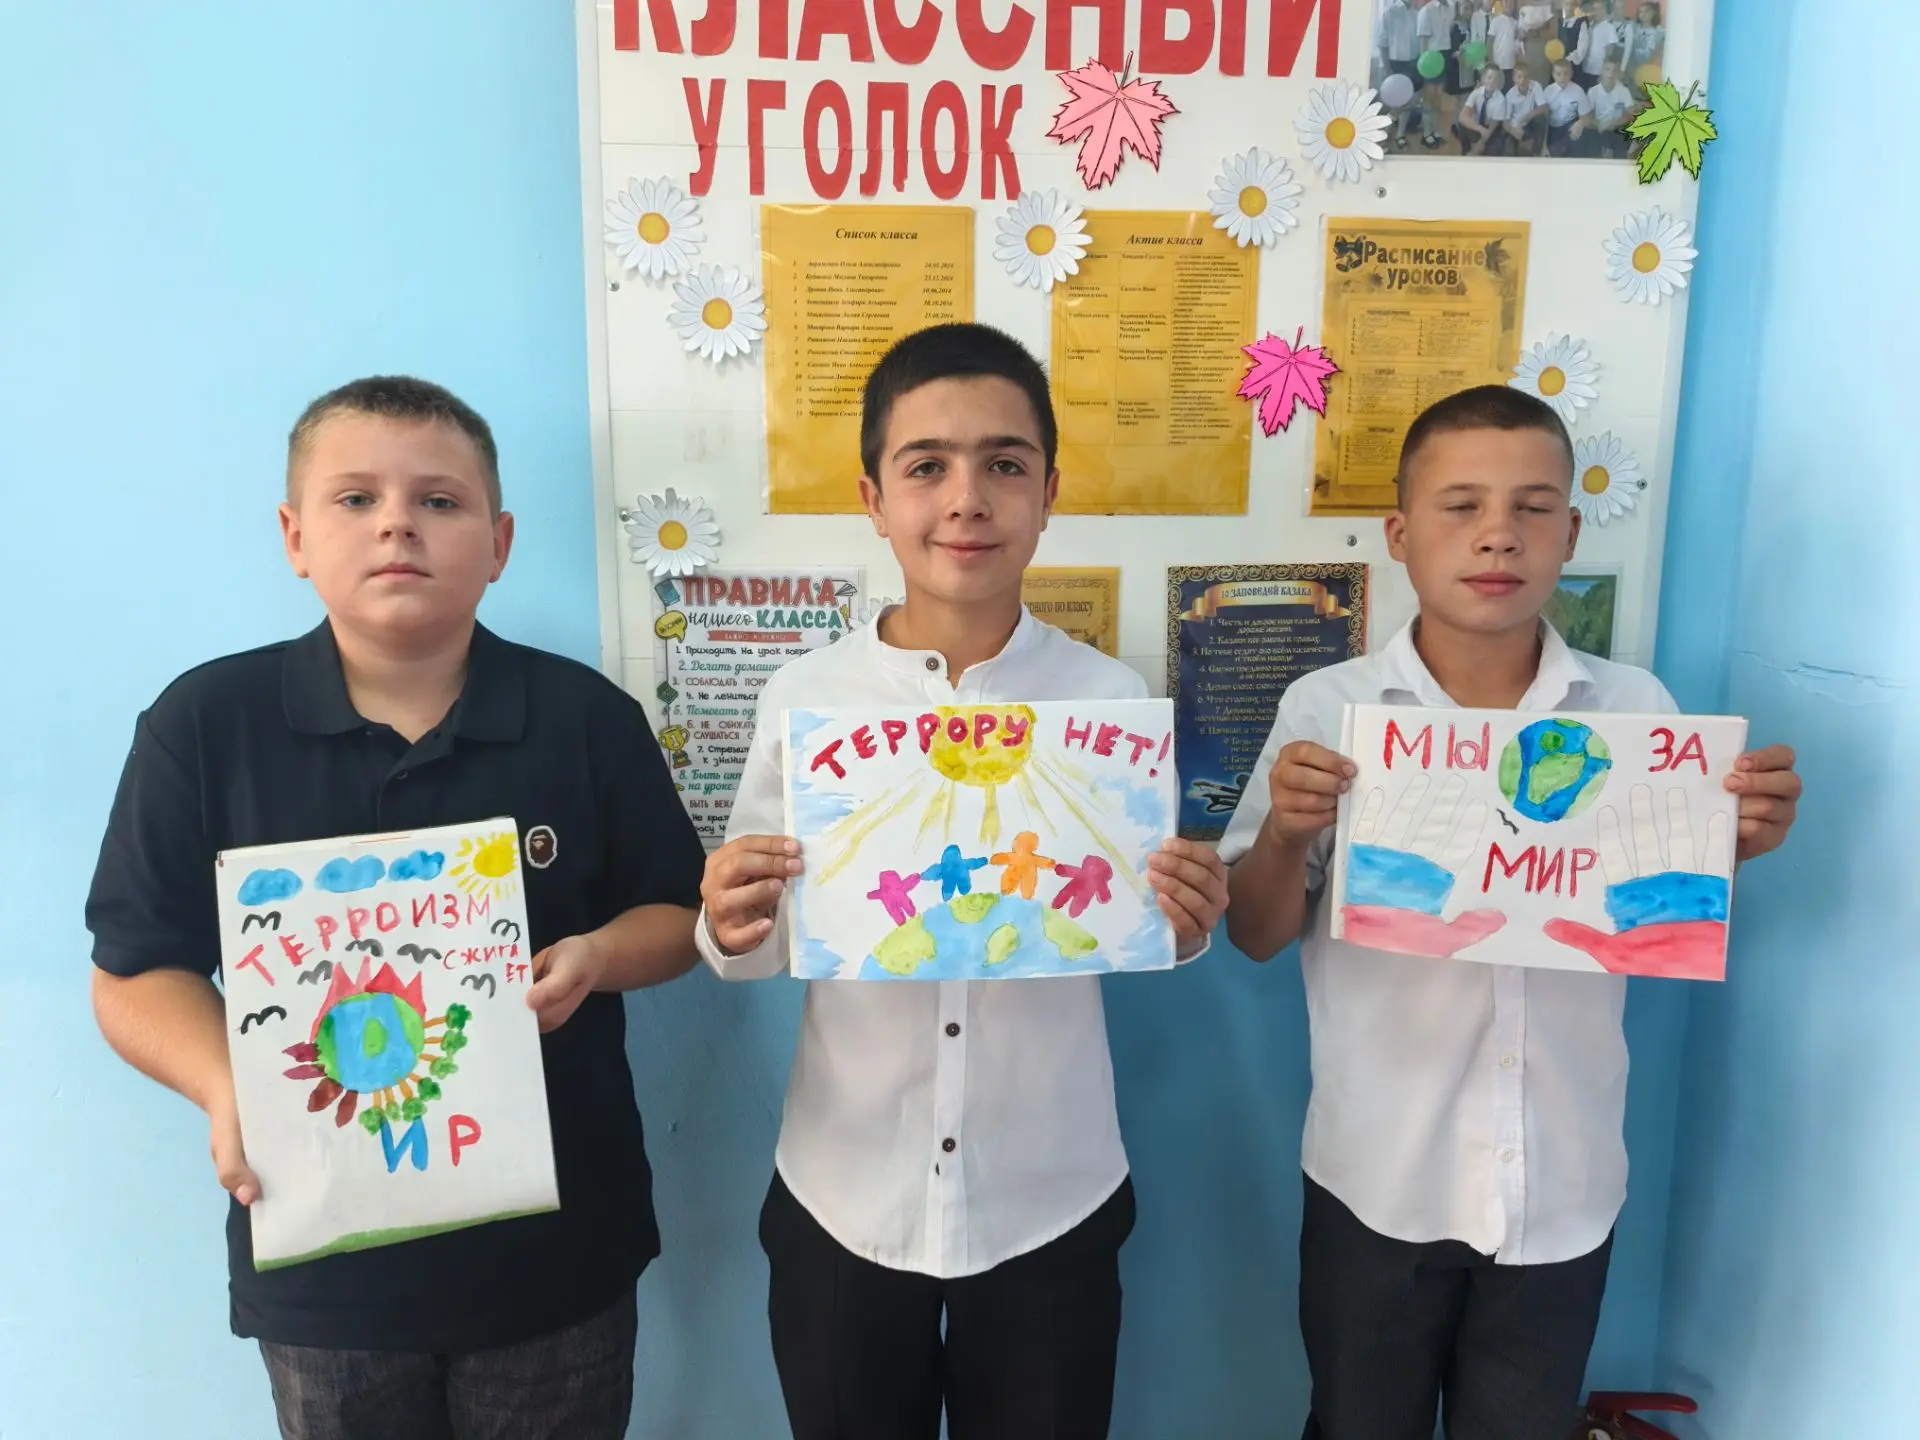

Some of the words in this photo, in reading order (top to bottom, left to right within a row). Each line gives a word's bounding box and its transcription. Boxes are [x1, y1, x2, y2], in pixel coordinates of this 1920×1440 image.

[682, 76, 1024, 201] УГОЛОК
[835, 227, 878, 240] Список
[879, 230, 919, 240] класса
[1126, 233, 1164, 245] Актив
[1166, 235, 1204, 246] класса
[1363, 240, 1486, 266] Расписание
[1386, 267, 1459, 289] уроков
[683, 575, 839, 608] ПРАВИЛА
[1230, 586, 1281, 599] ЗАПОВЕДЕЙ
[1280, 586, 1313, 598] КАЗАКА
[1066, 600, 1095, 617] классу
[688, 610, 755, 630] нашего
[756, 609, 843, 629] КЛАССА
[685, 645, 737, 658] Приходить
[757, 647, 782, 658] урок
[690, 660, 733, 672] Делать
[685, 677, 738, 687] СОБЛЮДАТЬ
[697, 691, 710, 701] Не
[685, 704, 740, 716] Помогать
[701, 720, 711, 729] НЕ
[718, 720, 757, 730] ОБИЖАТЬ
[693, 731, 741, 741] СЛУШАТЬСЯ
[810, 712, 1030, 780] ТЕРРОРУ
[1063, 715, 1172, 779] НЕТ!
[1383, 718, 1491, 772] МЫ
[1647, 727, 1709, 776] ЗА
[691, 768, 722, 780] Быть
[687, 782, 702, 791] на
[688, 799, 709, 809] БЫТЬ
[1481, 841, 1600, 899] МИР
[234, 893, 491, 988] ТЕРРОИЗМ
